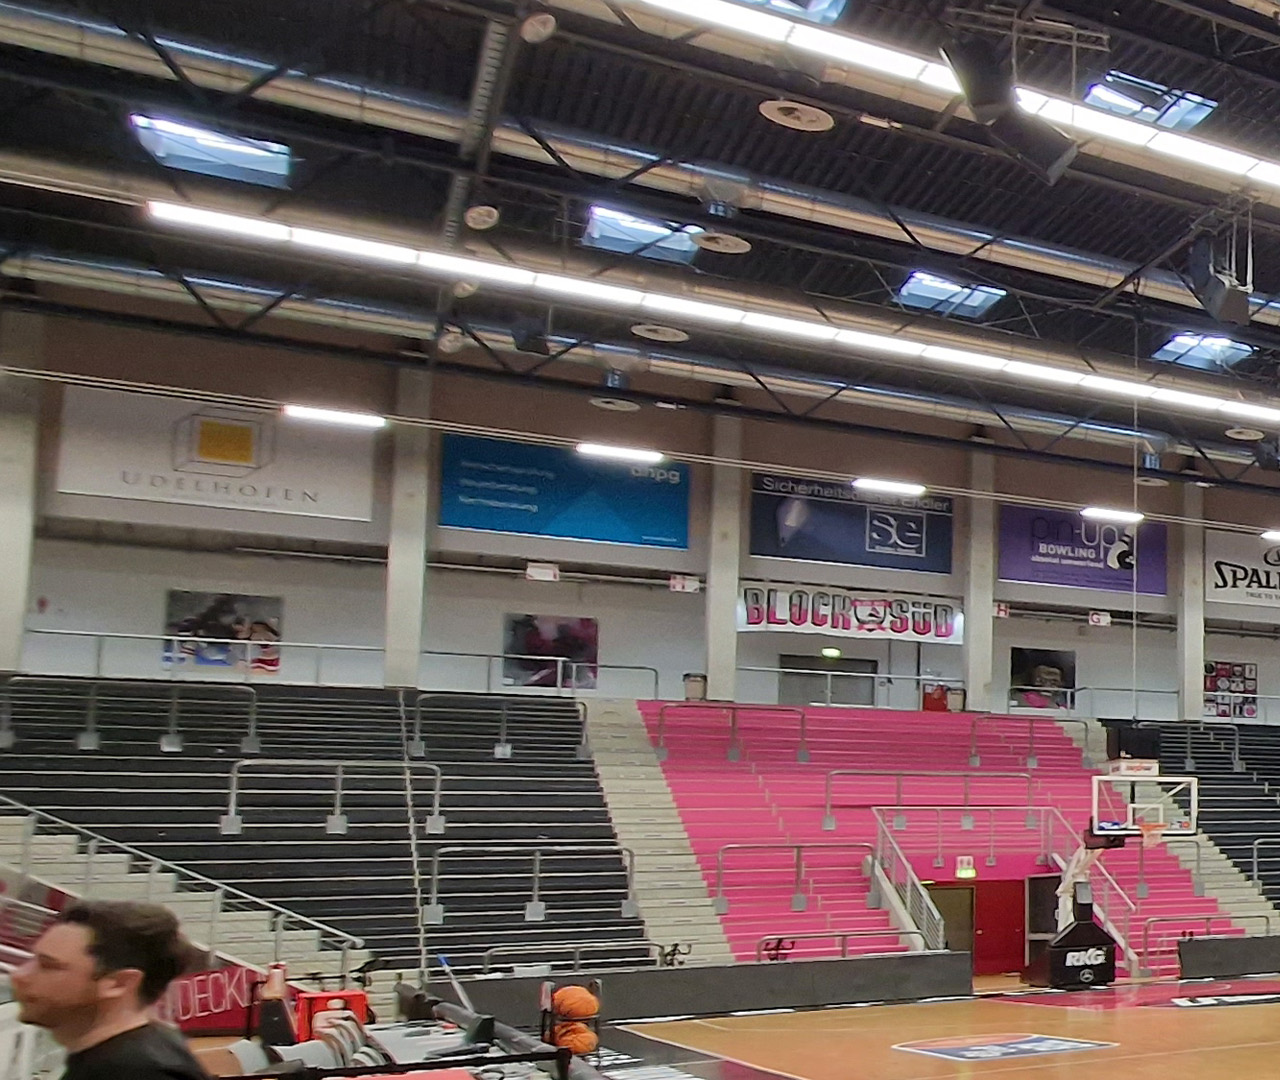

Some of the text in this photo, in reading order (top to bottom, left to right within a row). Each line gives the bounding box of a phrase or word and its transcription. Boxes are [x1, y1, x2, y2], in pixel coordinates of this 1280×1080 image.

[120, 470, 319, 503] UDELHOFEN
[1038, 543, 1097, 559] BOWLING
[744, 587, 954, 638] BLOCK SÜD
[1091, 612, 1101, 625] G
[1065, 948, 1107, 967] RKG
